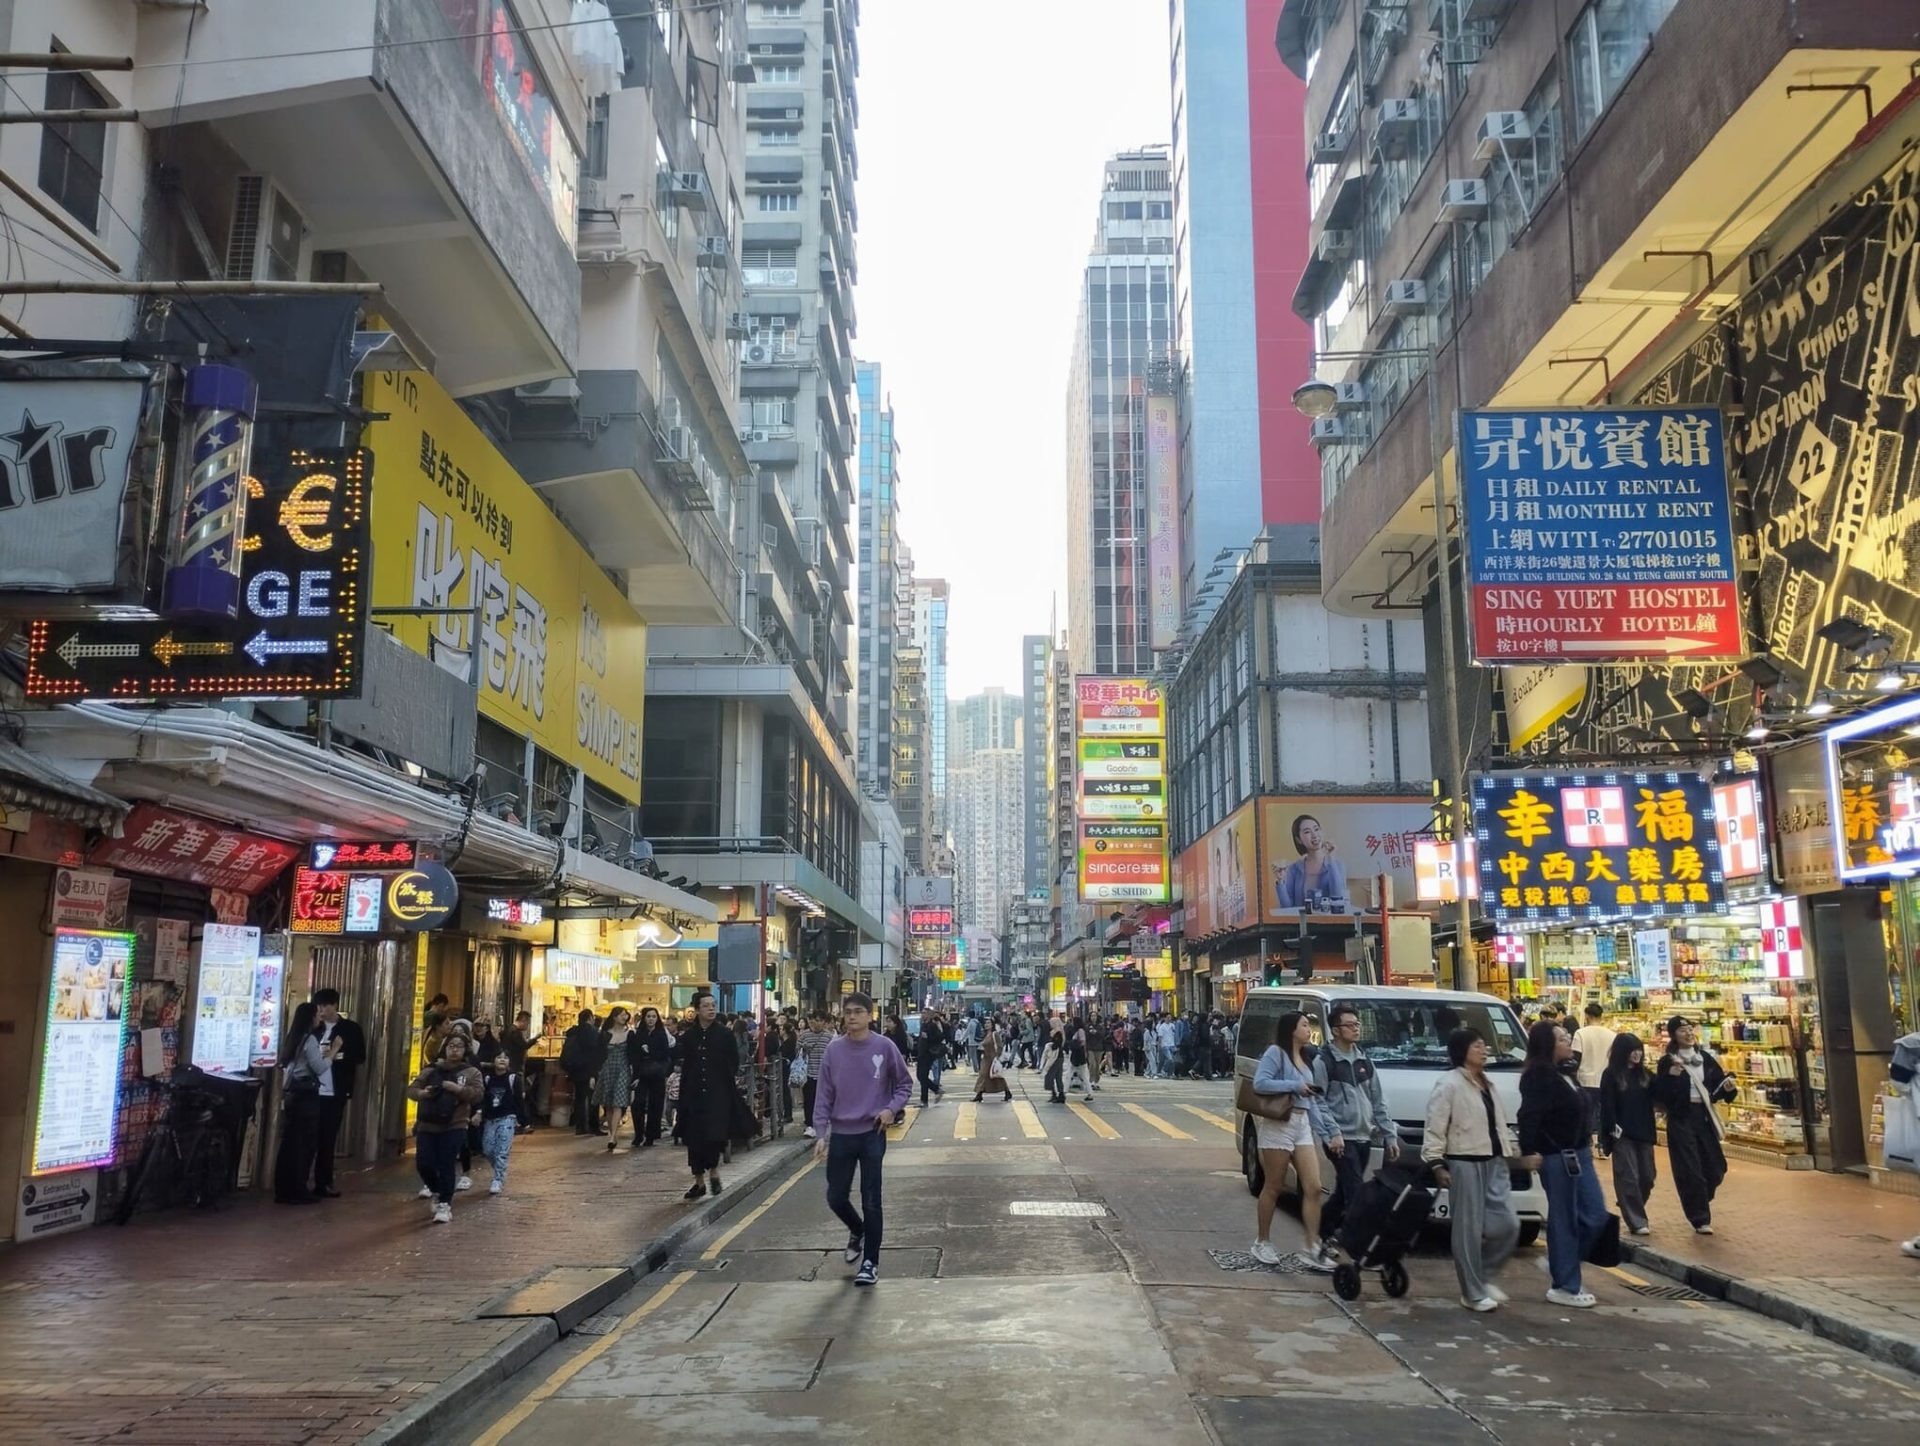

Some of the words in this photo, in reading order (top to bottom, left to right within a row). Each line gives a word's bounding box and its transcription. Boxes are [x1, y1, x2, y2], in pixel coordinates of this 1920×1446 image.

[1798, 304, 1860, 372] Prince
[1474, 414, 1713, 471] 昇悅賓館
[1799, 440, 1827, 485] 22
[420, 429, 514, 555] 點先可以拎到
[1486, 477, 1542, 498] 日租
[1546, 481, 1608, 496] DAILY
[1618, 479, 1701, 495] RENTAL
[1486, 500, 1544, 522] 月租
[1547, 503, 1648, 520] MONTHLY
[1658, 502, 1715, 518] RENT
[1485, 528, 1534, 551] 上網
[1536, 530, 1600, 549] WITI
[1618, 529, 1717, 550] 27701015
[1498, 573, 1520, 581] YUEN
[1546, 572, 1586, 581] BUILDING
[1616, 572, 1631, 580] SAI
[1633, 571, 1661, 580] YEUNG
[1699, 570, 1728, 579] SOUTH
[1485, 589, 1543, 610] SING
[1556, 589, 1617, 609] YUET
[1628, 588, 1726, 609] HOSTEL
[1771, 569, 1803, 660] Mercer
[1496, 638, 1559, 653] 按10字樓
[1496, 788, 1556, 849] 幸
[1633, 787, 1696, 843] 福
[132, 817, 269, 872] 新華賓館
[1088, 862, 1140, 874] sincere
[1497, 845, 1705, 885] 中西大藥房
[314, 892, 341, 906] 2/F
[1111, 887, 1153, 896] SUSHIRO
[1500, 886, 1592, 907] 免稅批發
[1614, 882, 1710, 905] 蟲草燕窩
